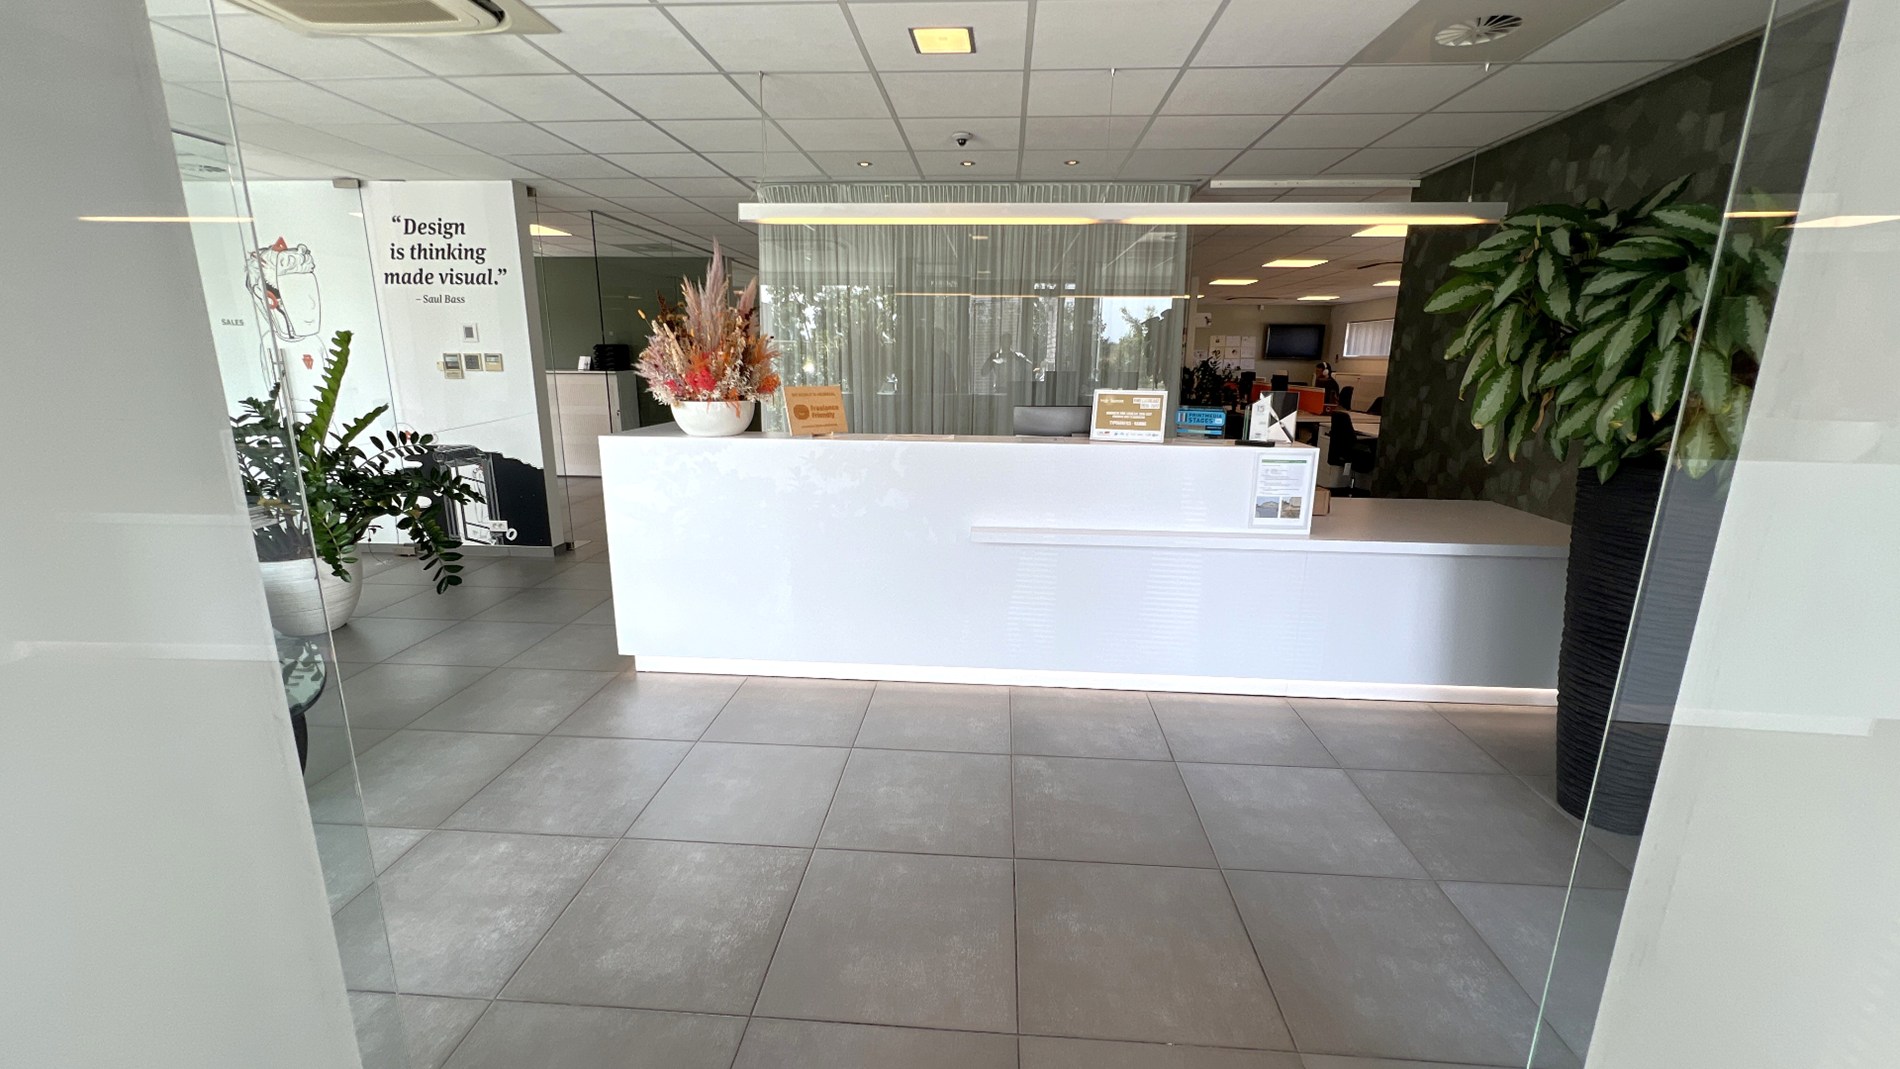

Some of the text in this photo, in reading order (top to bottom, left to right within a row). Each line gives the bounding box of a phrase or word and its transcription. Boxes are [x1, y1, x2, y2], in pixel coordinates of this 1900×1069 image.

[390, 243, 487, 265] is thinking
[384, 268, 507, 285] made visual.”
[423, 294, 442, 303] Saul
[444, 294, 466, 303] Bass
[221, 318, 244, 326] SALES
